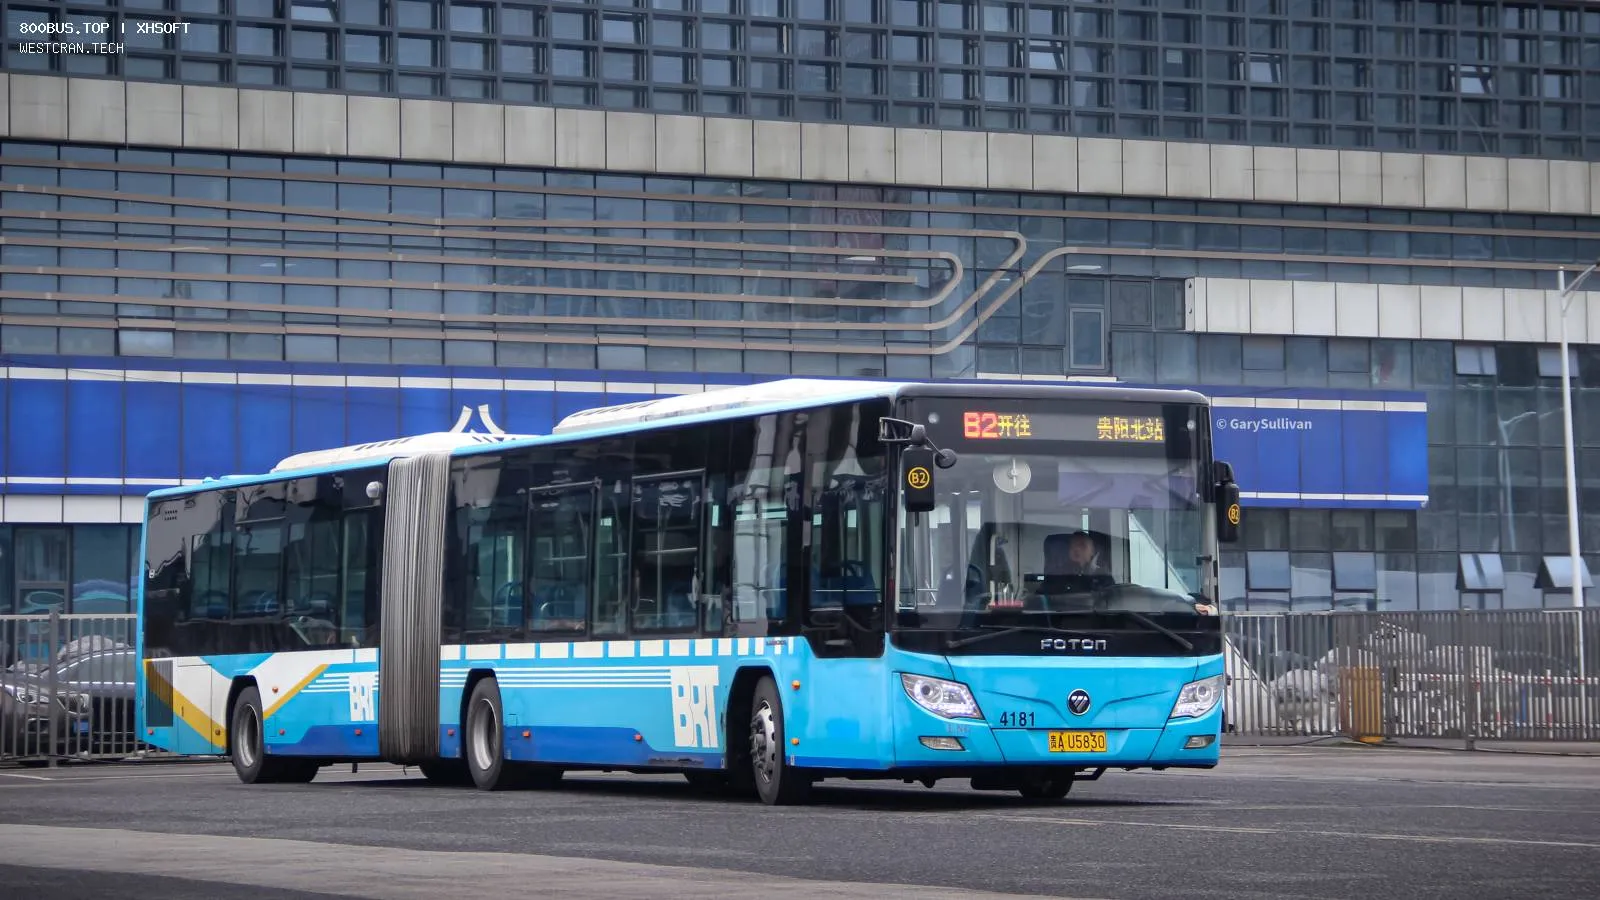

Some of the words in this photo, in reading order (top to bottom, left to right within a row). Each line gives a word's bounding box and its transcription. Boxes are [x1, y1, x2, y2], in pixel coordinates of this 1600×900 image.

[1097, 416, 1165, 441] 贵阳北站
[911, 472, 926, 484] B2
[1230, 508, 1240, 520] B2
[1040, 638, 1107, 651] FOTON
[671, 665, 719, 748] BRT
[1000, 711, 1035, 727] 4181
